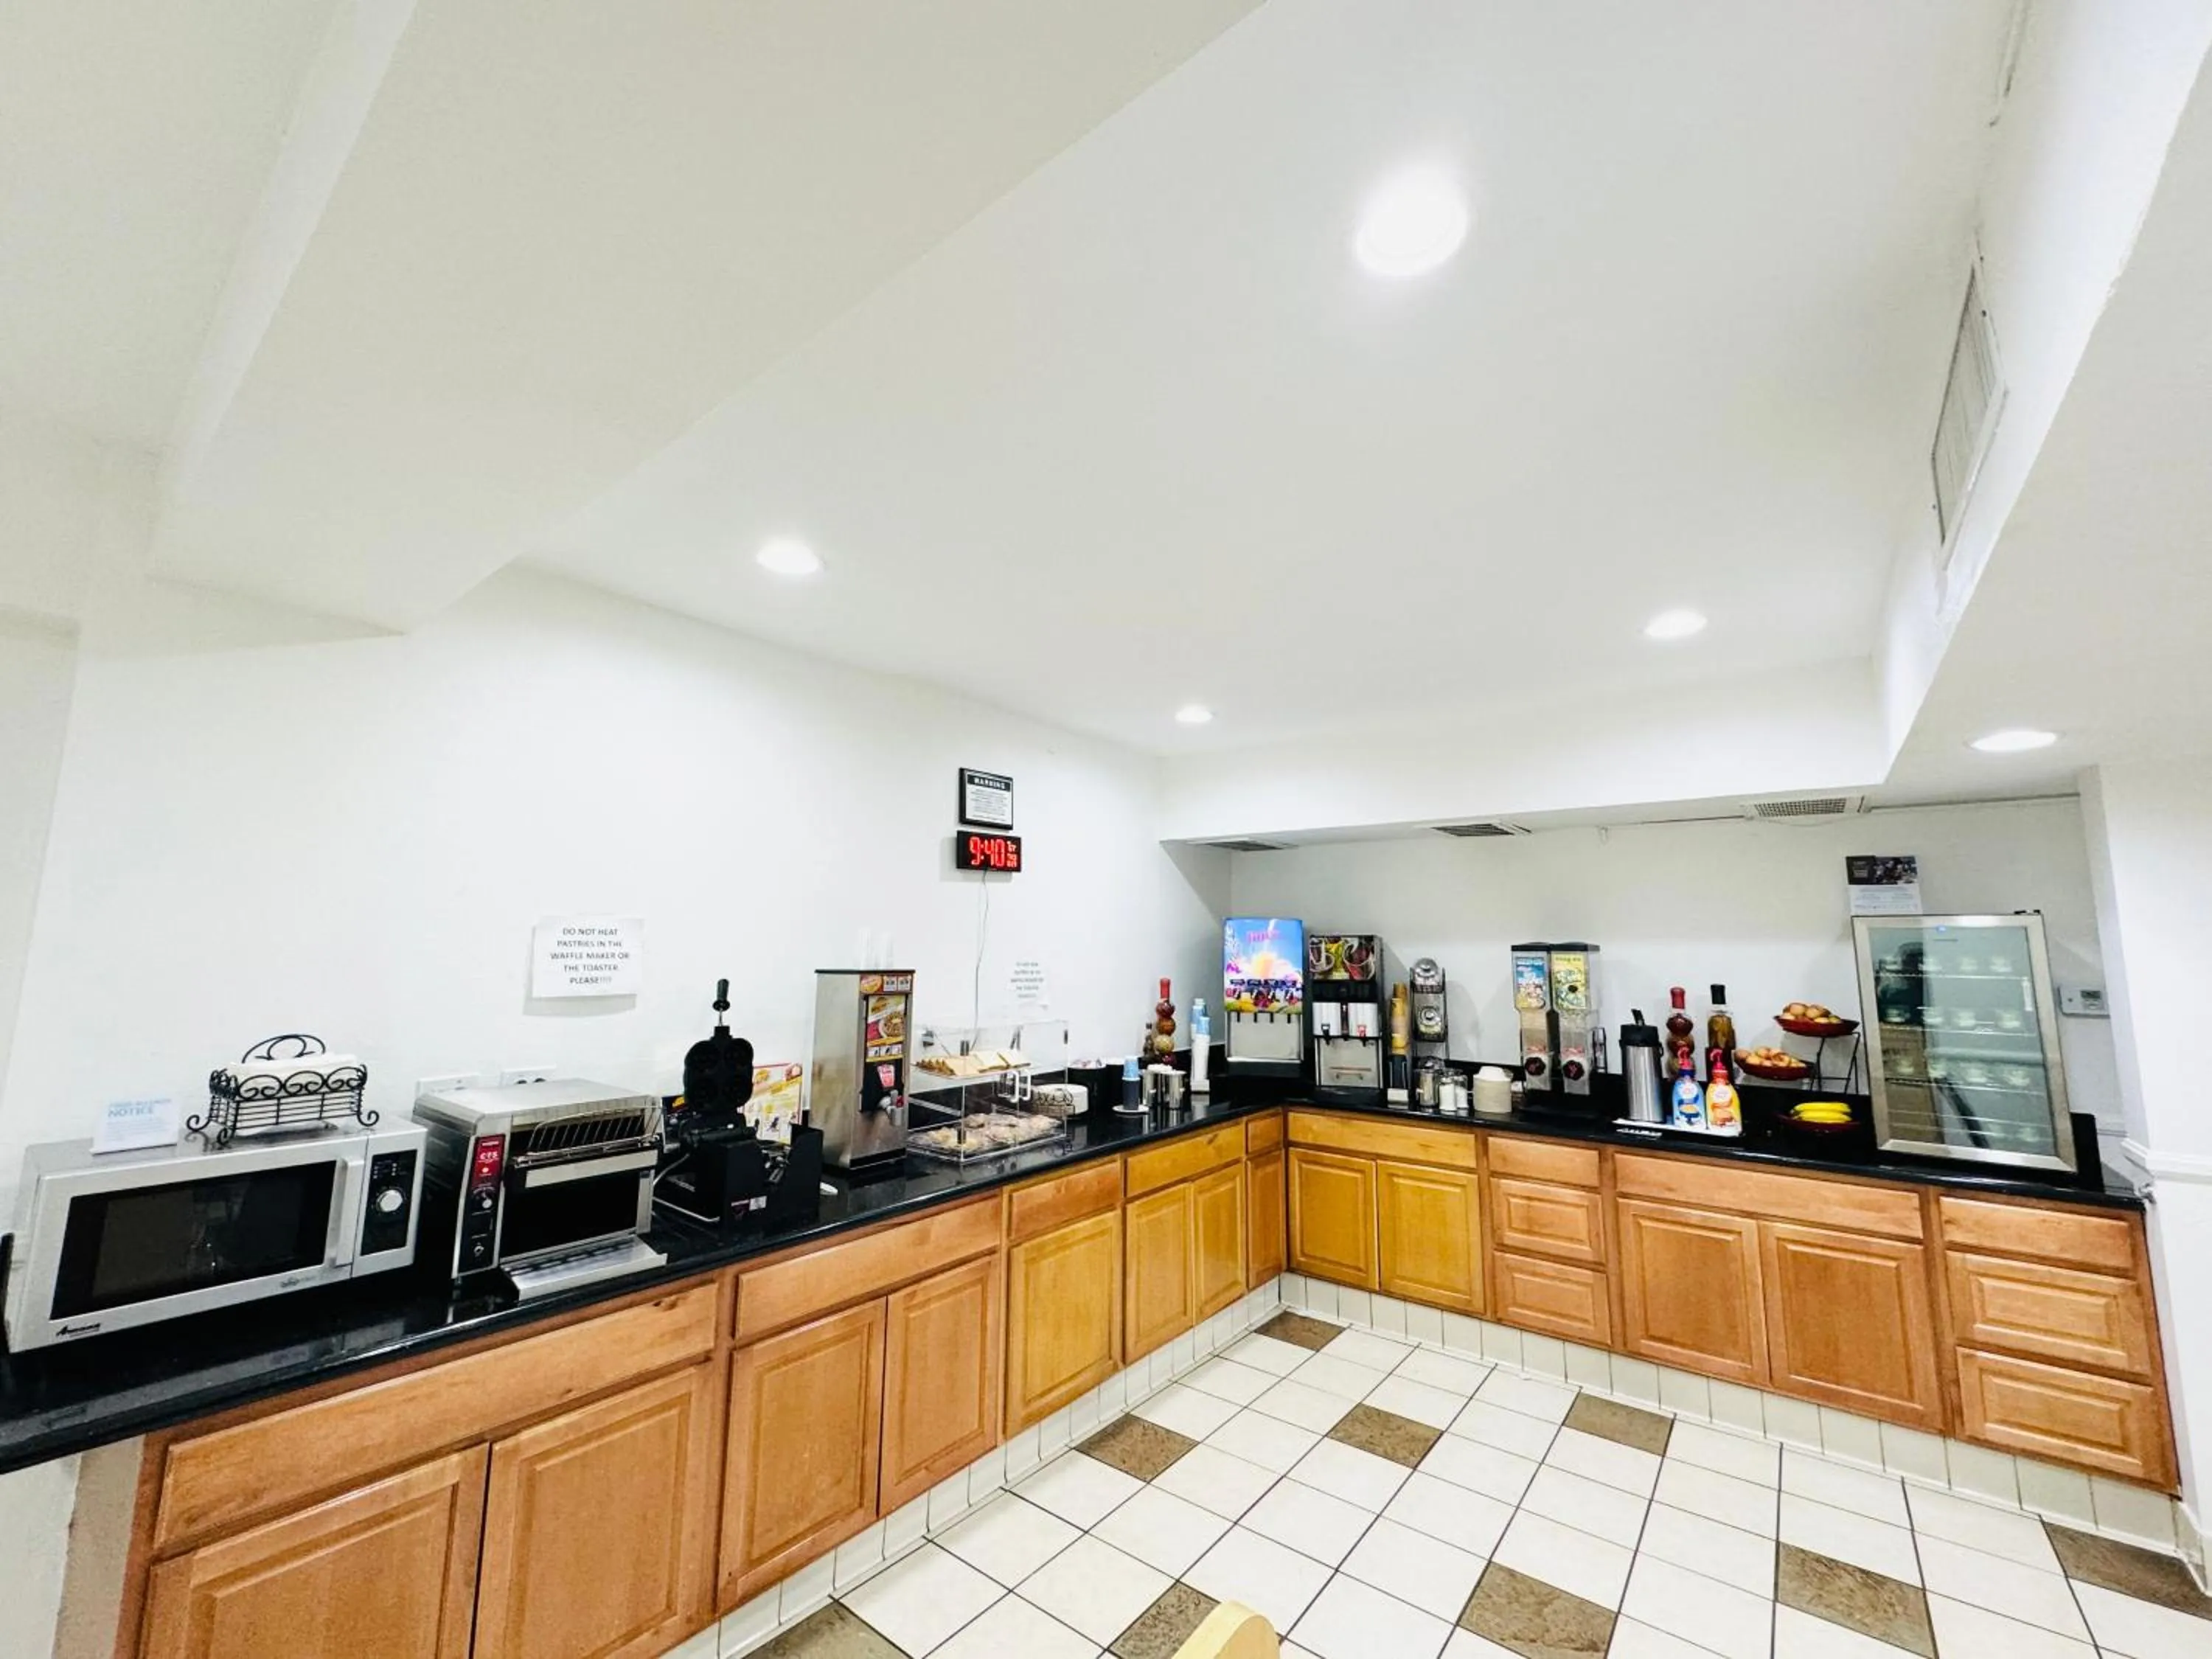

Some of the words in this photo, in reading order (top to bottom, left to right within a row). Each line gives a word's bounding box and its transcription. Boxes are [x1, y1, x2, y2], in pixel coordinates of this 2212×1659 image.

[973, 777, 1006, 790] WARNING
[970, 836, 1005, 867] 9:40
[562, 928, 576, 936] DO
[578, 928, 595, 936] NOT
[598, 928, 618, 936] HEAT
[108, 1107, 153, 1118] NOTICE
